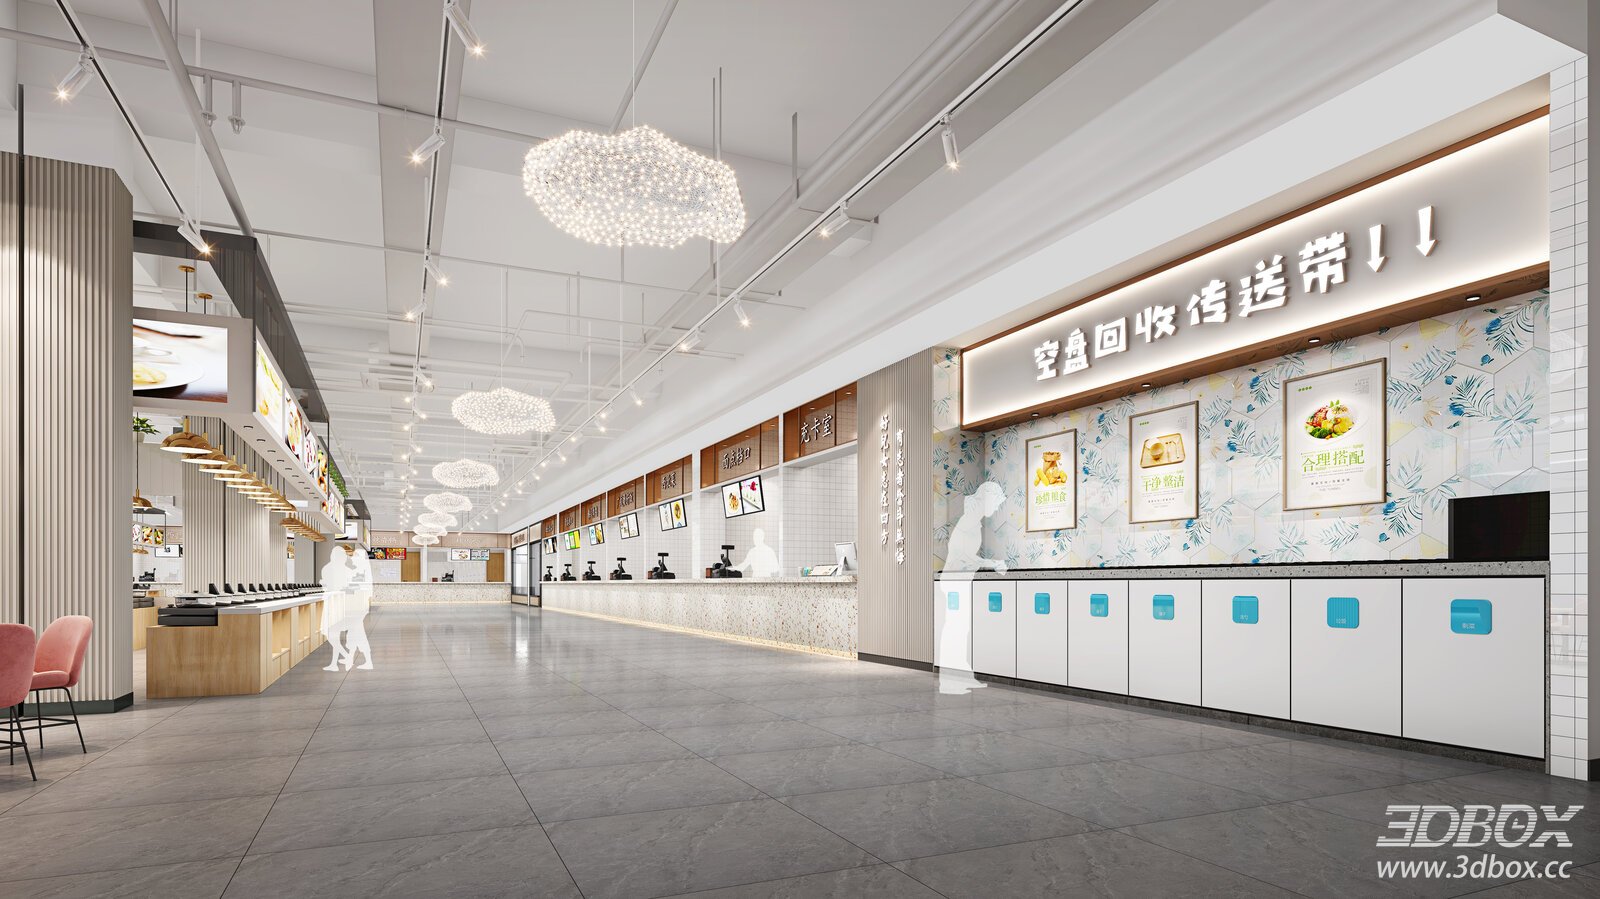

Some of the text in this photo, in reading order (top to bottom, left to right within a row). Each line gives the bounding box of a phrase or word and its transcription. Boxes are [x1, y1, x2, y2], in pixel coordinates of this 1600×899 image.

[1033, 231, 1350, 382] 空盘回收传送带
[799, 413, 833, 444] 充卡室
[1301, 449, 1365, 473] 合理搭配
